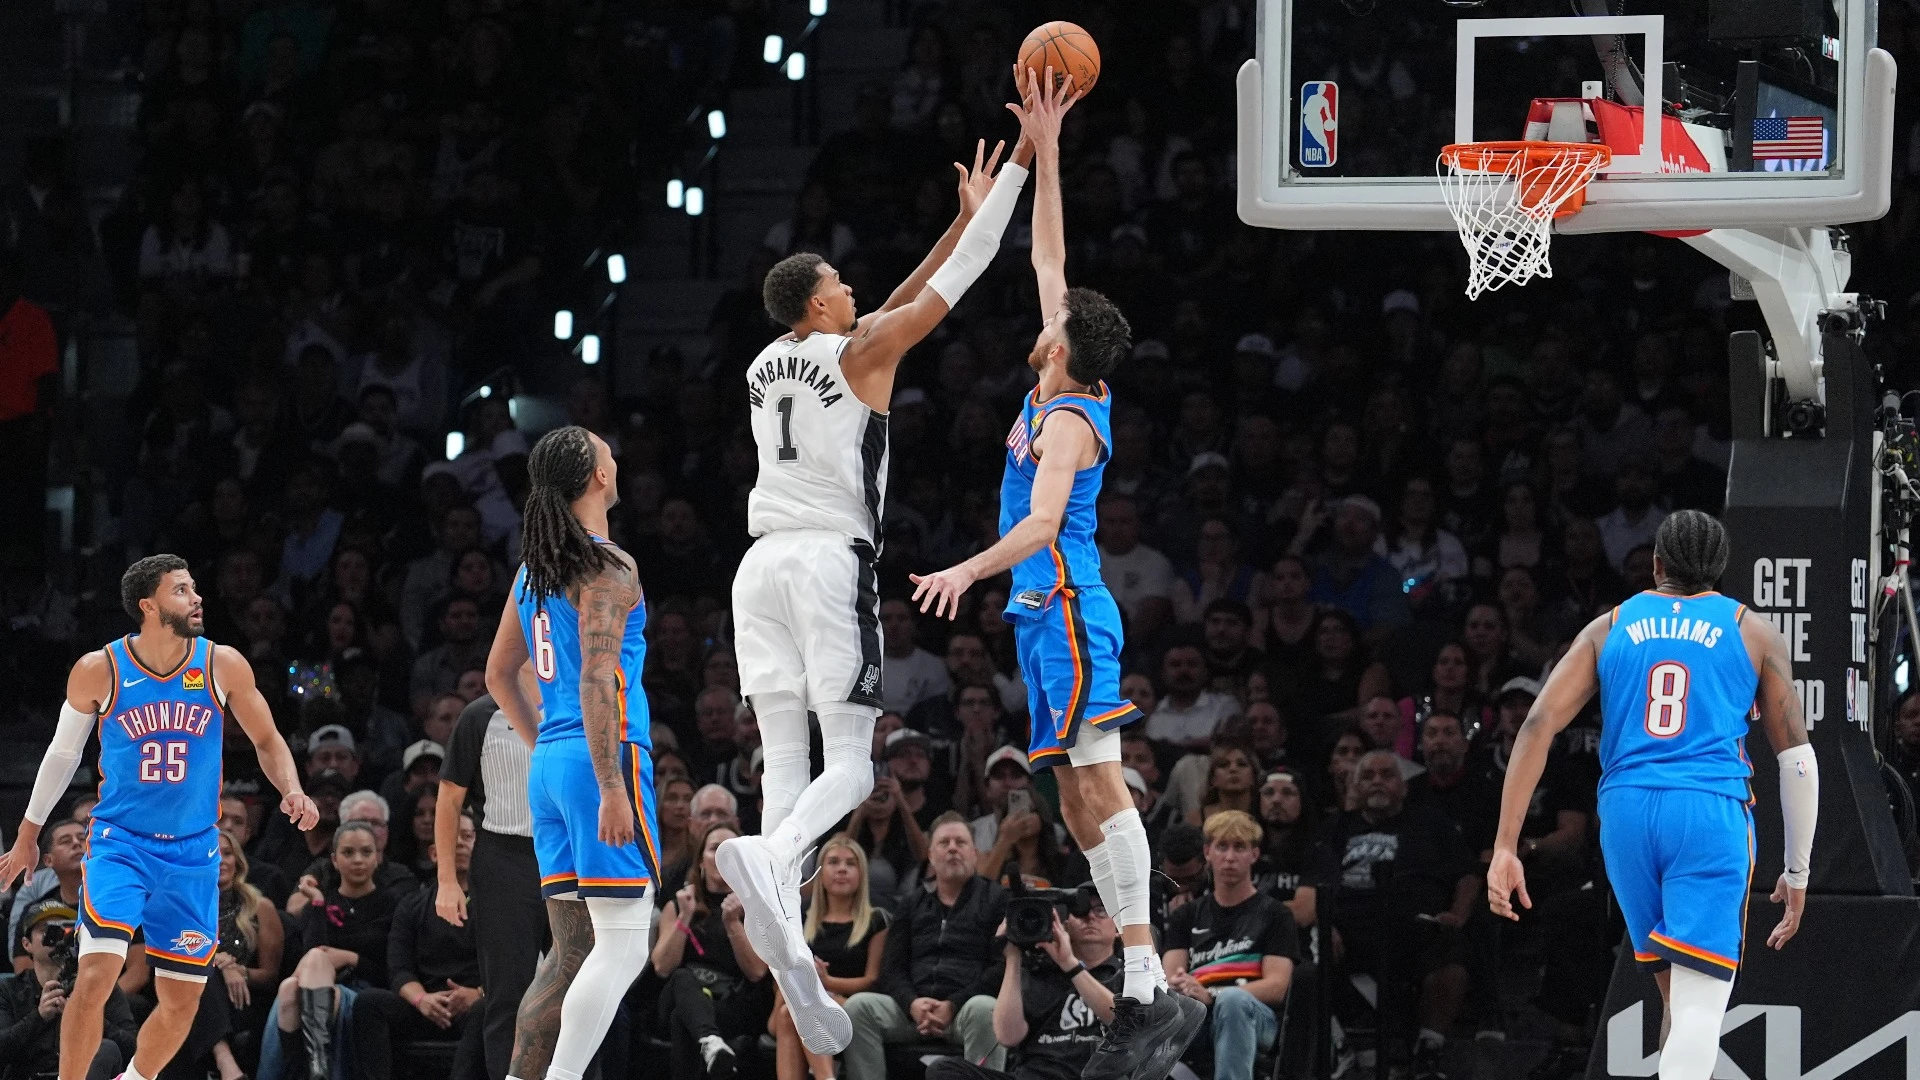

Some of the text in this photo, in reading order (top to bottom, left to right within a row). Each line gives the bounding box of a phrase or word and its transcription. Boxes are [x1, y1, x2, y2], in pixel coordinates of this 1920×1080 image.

[1305, 147, 1322, 161] NBA
[750, 356, 843, 409] WEMBANYAMA
[776, 393, 799, 464] 1
[1753, 557, 1811, 607] GET
[1851, 557, 1866, 608] GET
[532, 610, 556, 684] 6
[1625, 617, 1723, 649] WILLIAMS
[1758, 612, 1811, 662] HE
[1850, 613, 1866, 663] THE
[116, 700, 213, 740] THUNDER
[1644, 659, 1690, 739] 8
[139, 740, 188, 784] 25
[1206, 936, 1255, 961] Antonio
